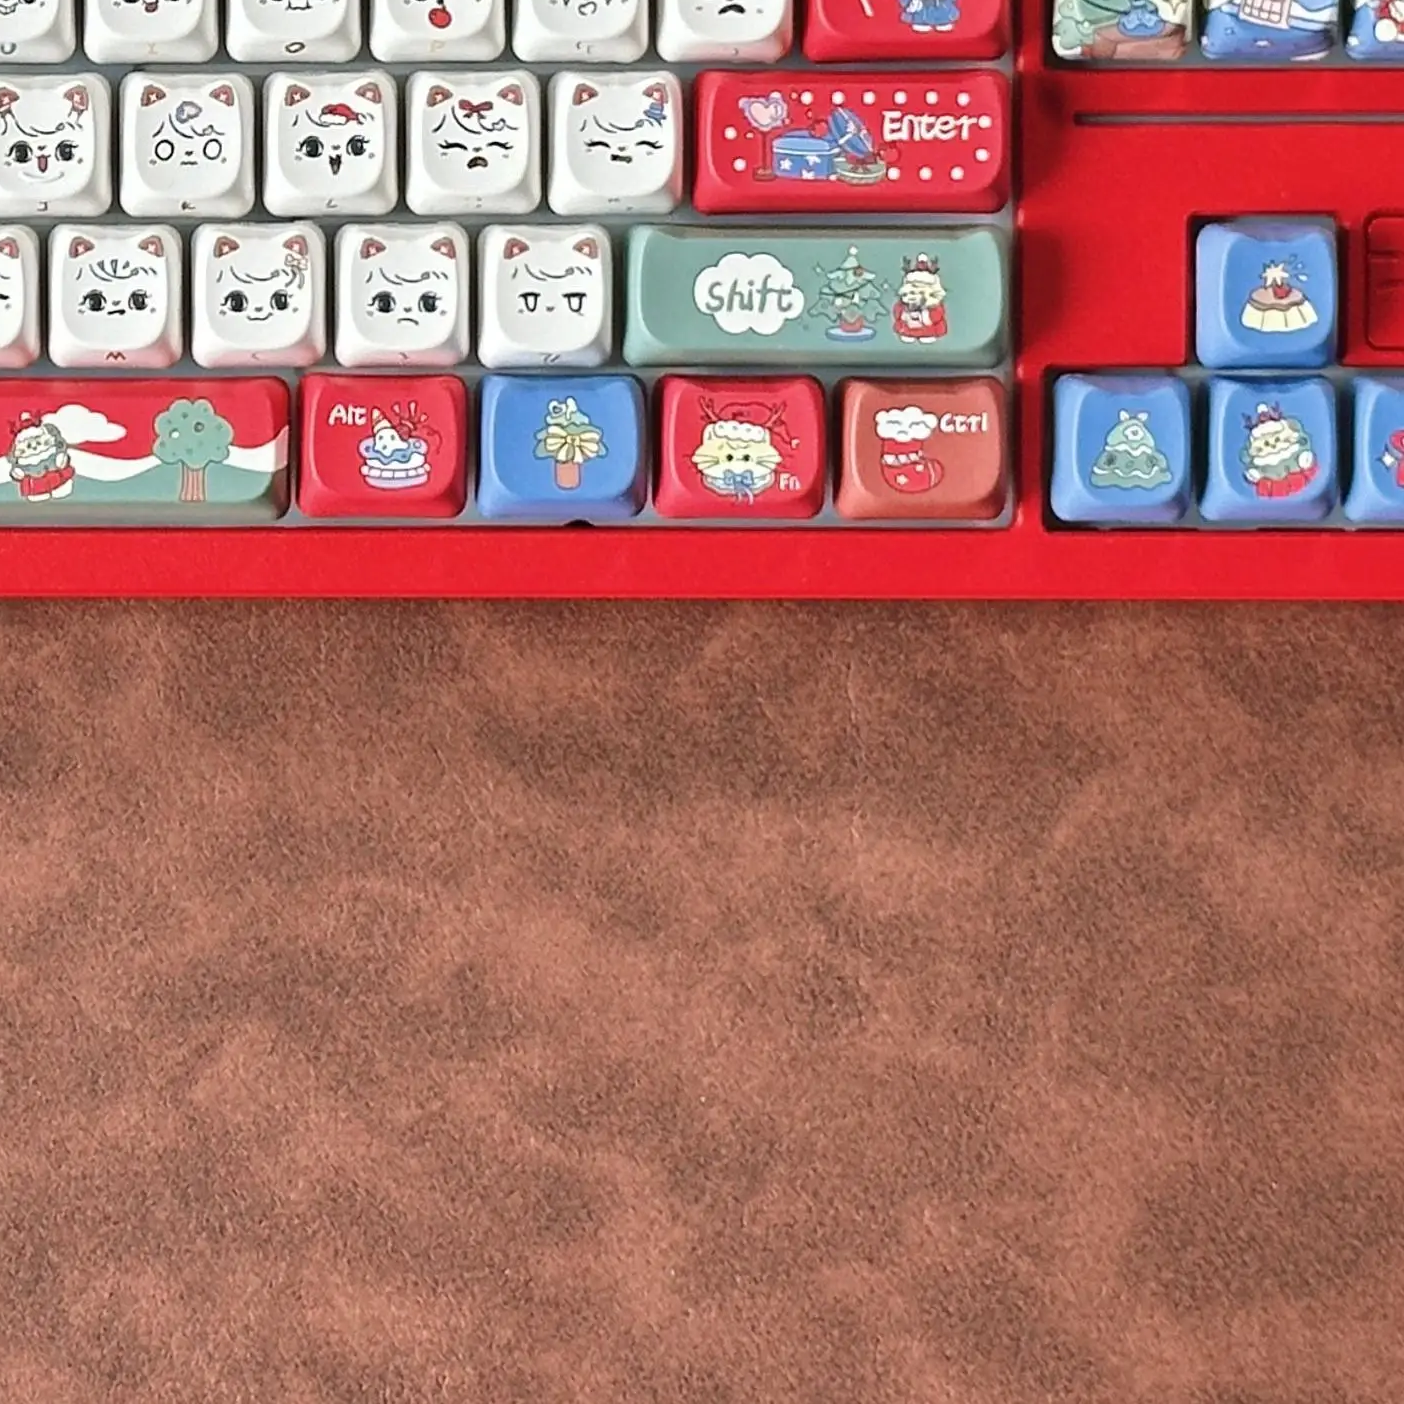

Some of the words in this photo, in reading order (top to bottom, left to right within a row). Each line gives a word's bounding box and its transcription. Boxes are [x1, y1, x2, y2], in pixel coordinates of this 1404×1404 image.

[0, 42, 17, 55] U
[285, 40, 306, 54] O
[883, 111, 978, 142] Enter
[36, 200, 48, 212] J
[705, 278, 793, 315] Shift
[105, 351, 126, 361] M
[328, 403, 366, 427] Alt
[940, 412, 988, 433] Ctrl
[779, 472, 801, 491] Fn
